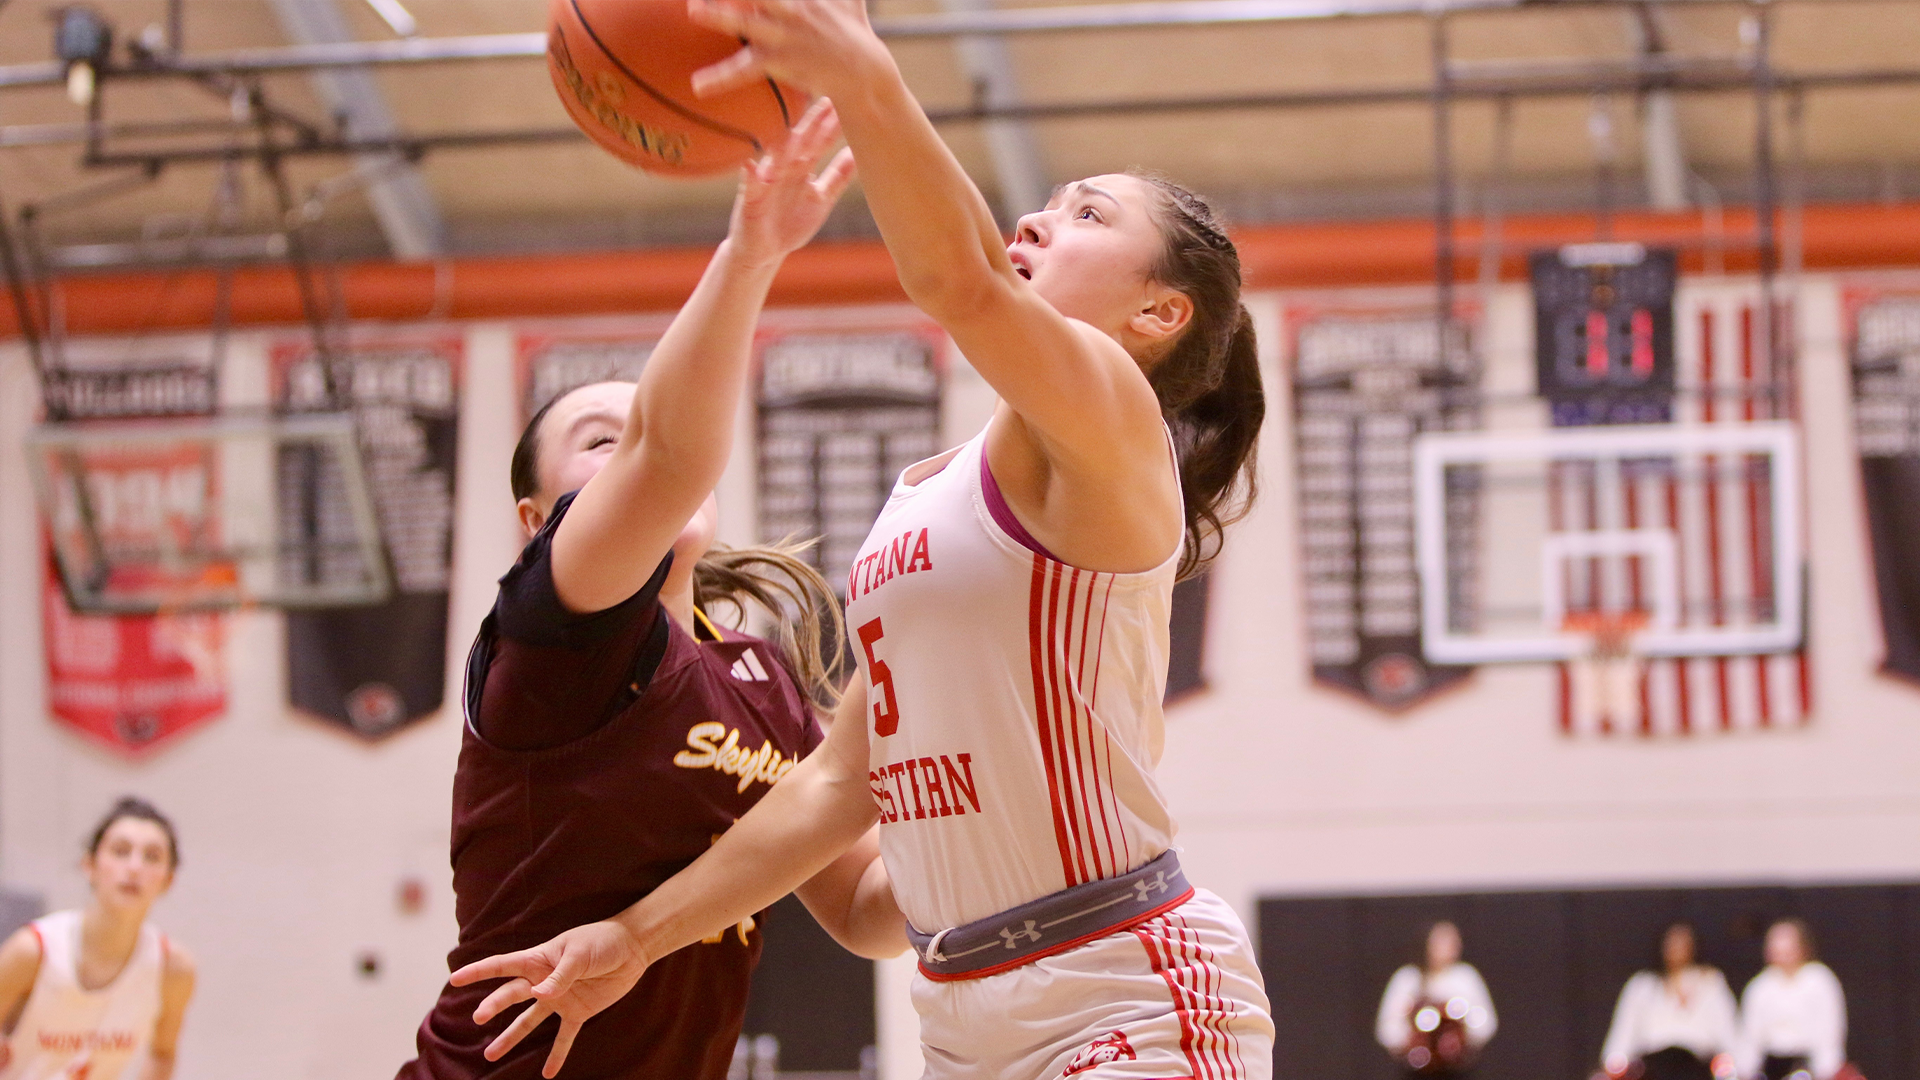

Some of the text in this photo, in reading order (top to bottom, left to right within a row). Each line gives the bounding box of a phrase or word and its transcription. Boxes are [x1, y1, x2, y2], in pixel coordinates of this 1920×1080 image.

[846, 527, 933, 607] NTANA
[857, 616, 900, 739] 5
[673, 720, 799, 795] Skyli
